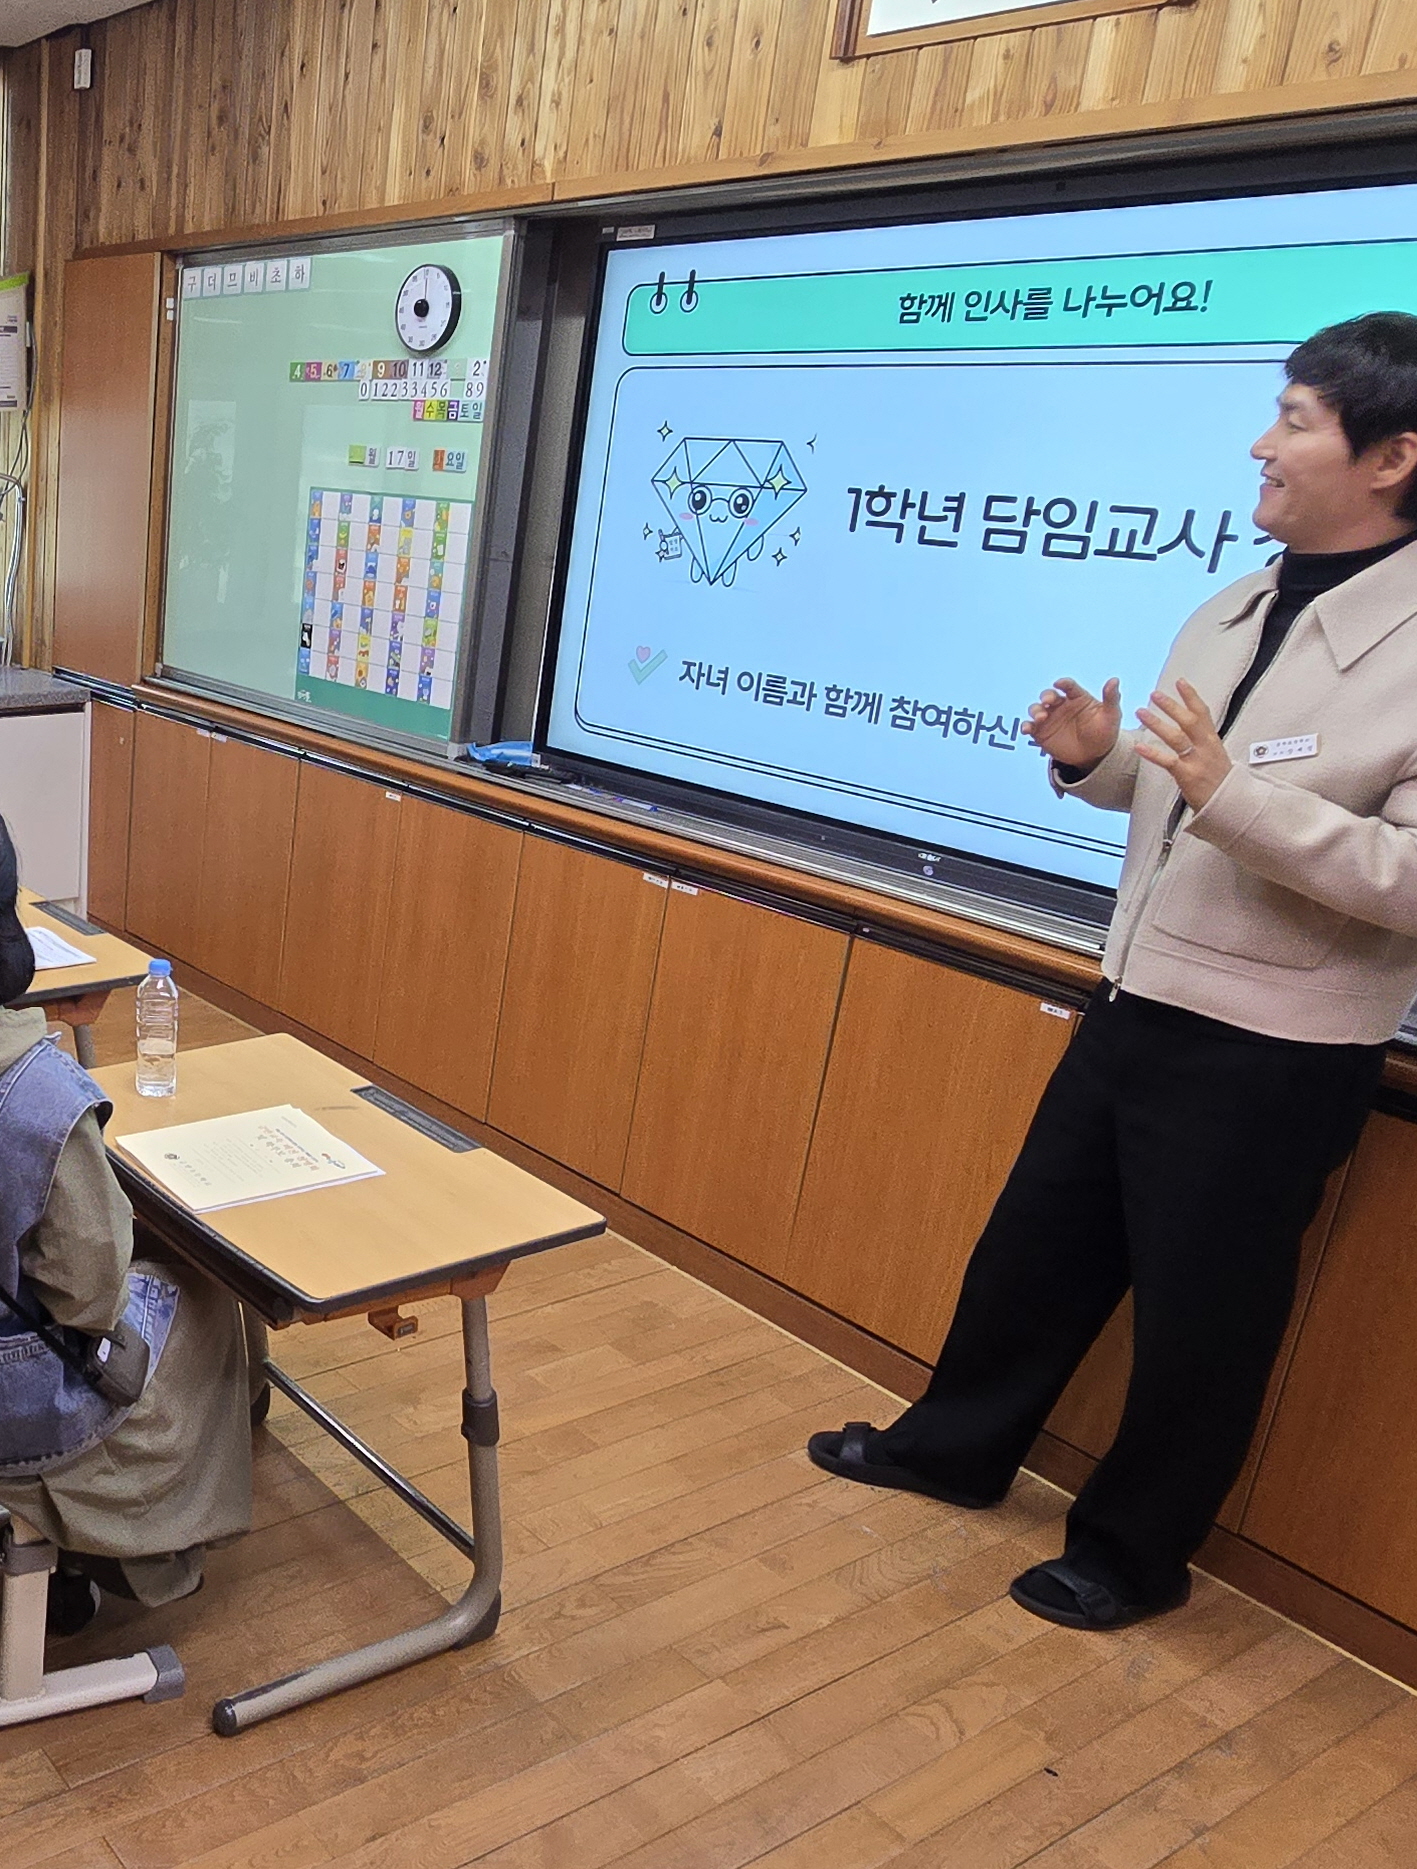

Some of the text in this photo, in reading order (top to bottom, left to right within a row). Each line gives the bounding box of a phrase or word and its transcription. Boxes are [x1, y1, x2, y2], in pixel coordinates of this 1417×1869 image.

[187, 263, 305, 293] 구 더 므 비 초 하
[898, 279, 1214, 325] 함께 인사를 나누어요!
[342, 362, 351, 379] 7
[376, 361, 385, 379] 9
[392, 361, 407, 379] 10
[412, 360, 425, 378] 11
[428, 361, 442, 377] 12
[472, 360, 481, 377] 2
[360, 381, 368, 397] 0
[846, 483, 967, 549] 1학년
[981, 494, 1240, 575] 담임교사
[678, 660, 730, 696] 자녀
[736, 671, 818, 712] 이름과
[823, 684, 884, 725] 함께
[888, 695, 1021, 751] 참여하신
